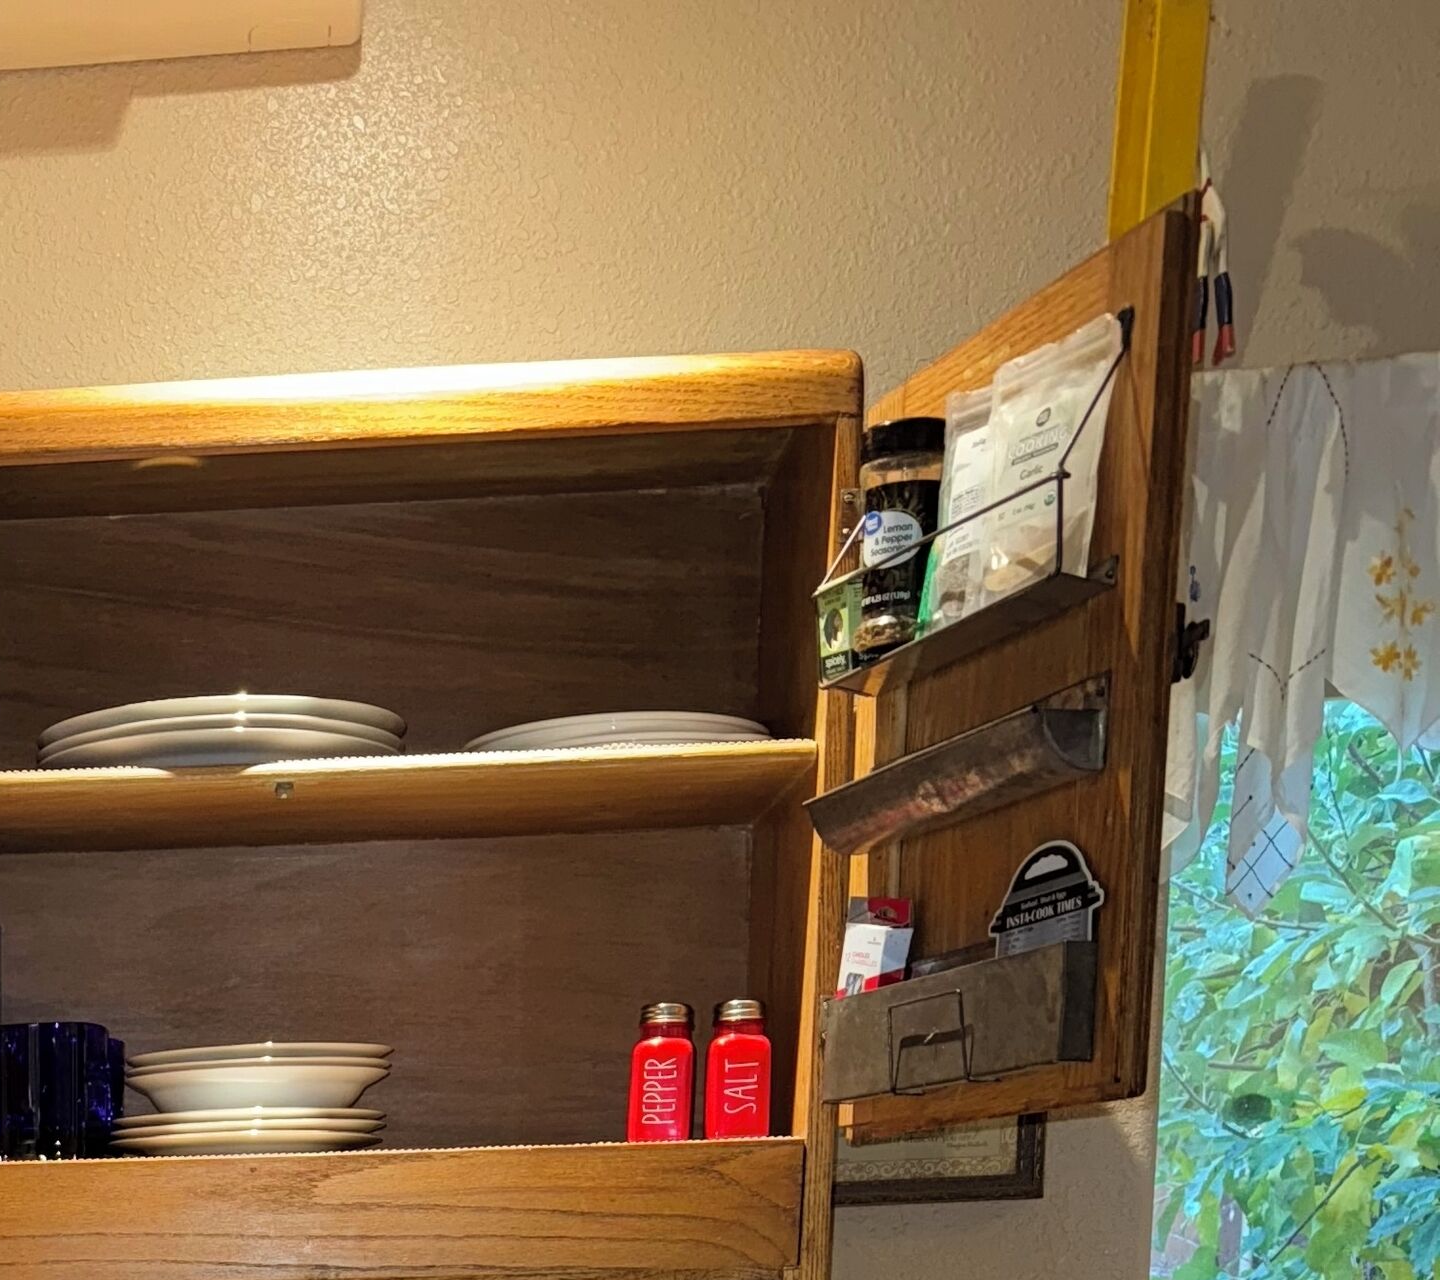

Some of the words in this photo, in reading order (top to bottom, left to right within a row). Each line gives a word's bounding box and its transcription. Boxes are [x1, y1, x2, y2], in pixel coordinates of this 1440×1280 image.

[883, 523, 914, 534] Lemon
[881, 533, 913, 545] Pepper
[1056, 895, 1083, 915] TIMES
[641, 1057, 678, 1125] PEPPER
[723, 1058, 760, 1115] SALT
